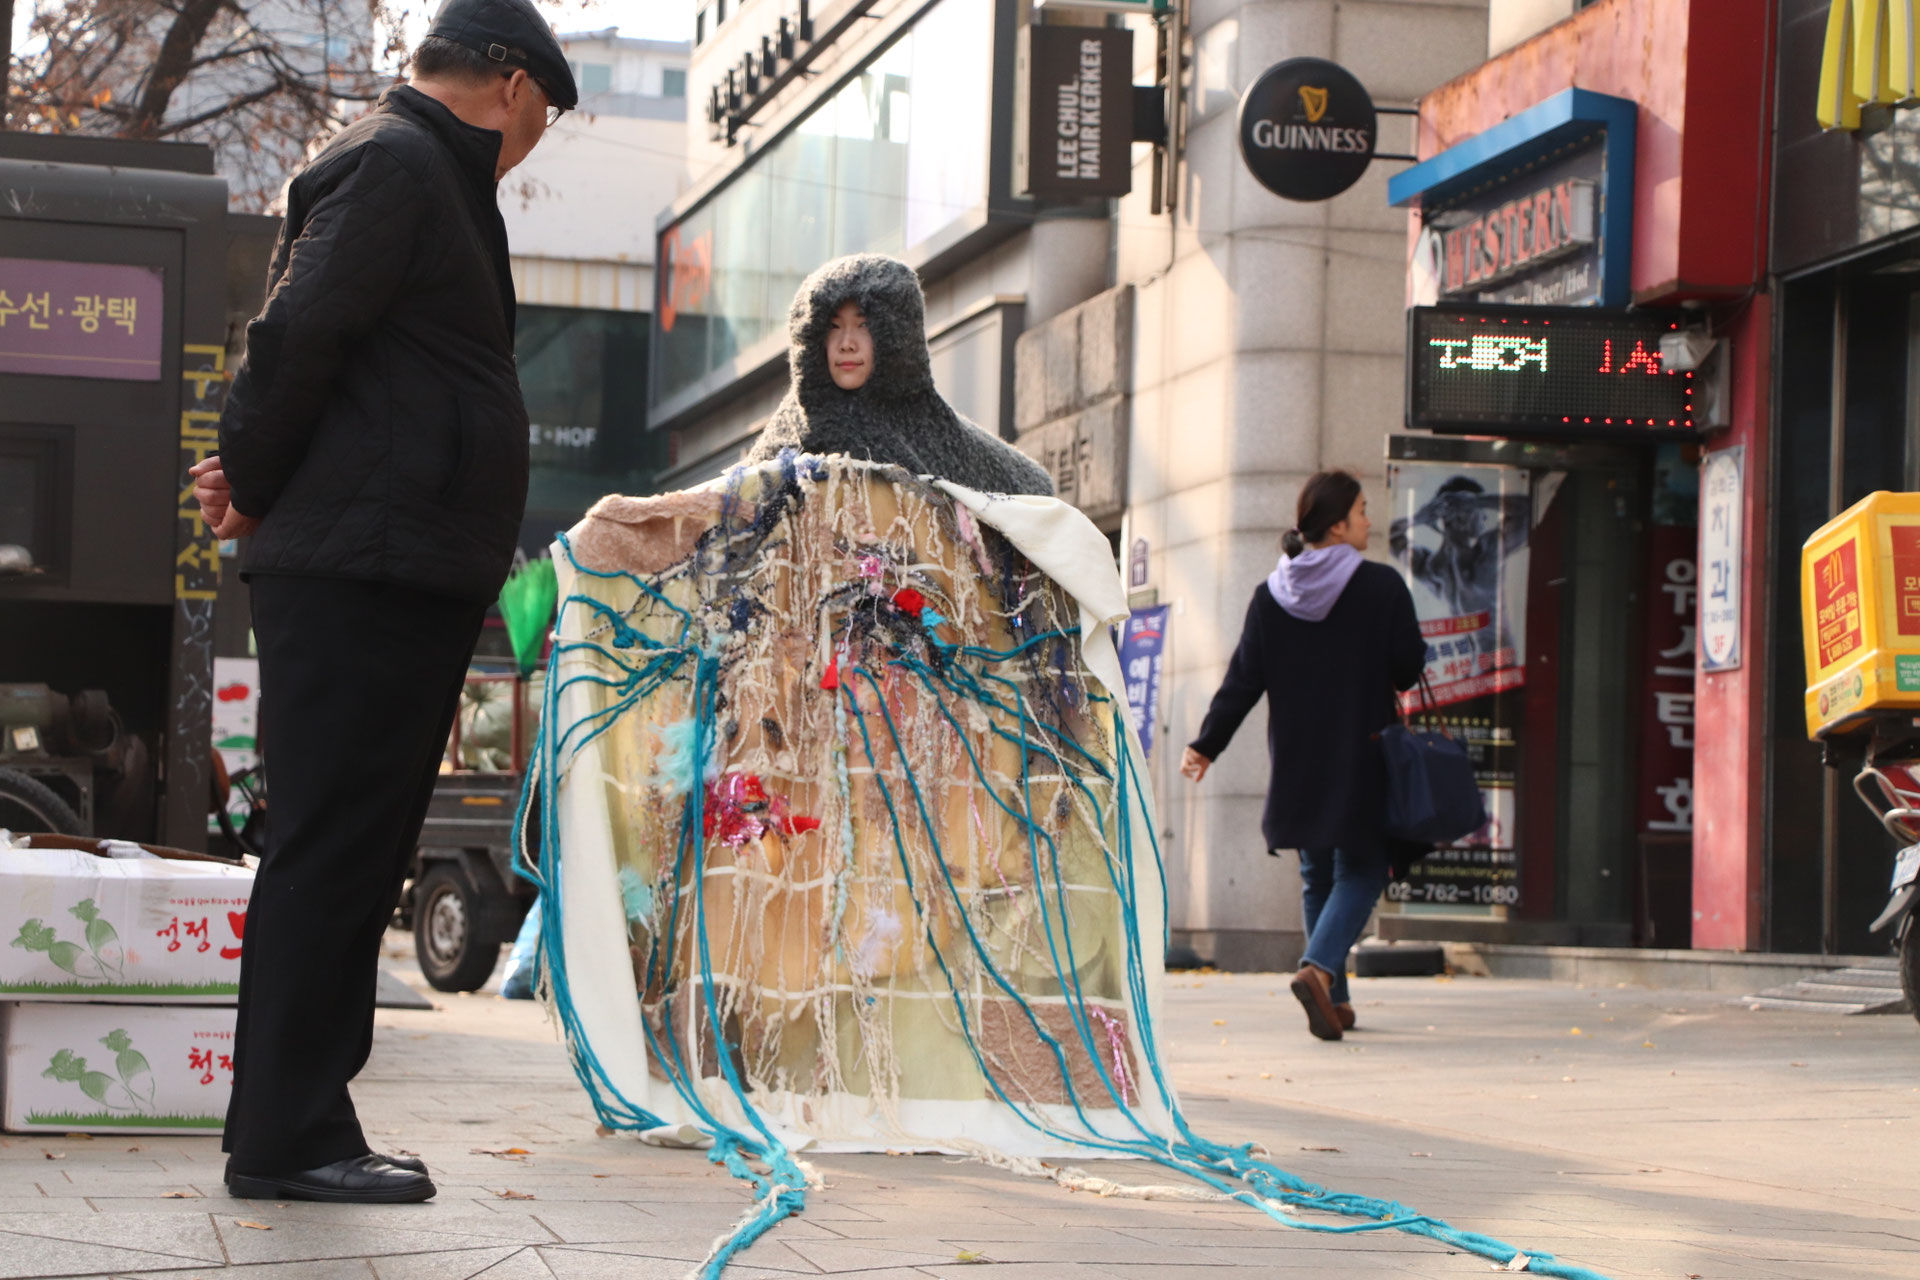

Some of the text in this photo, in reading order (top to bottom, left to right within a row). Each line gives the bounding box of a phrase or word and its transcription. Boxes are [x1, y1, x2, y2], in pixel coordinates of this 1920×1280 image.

[1057, 139, 1078, 179] LEE
[1079, 39, 1102, 180] HAIRKERKER
[1252, 119, 1369, 154] GUINNESS
[1445, 181, 1576, 294] WESTERN
[1710, 503, 1731, 602] 치과
